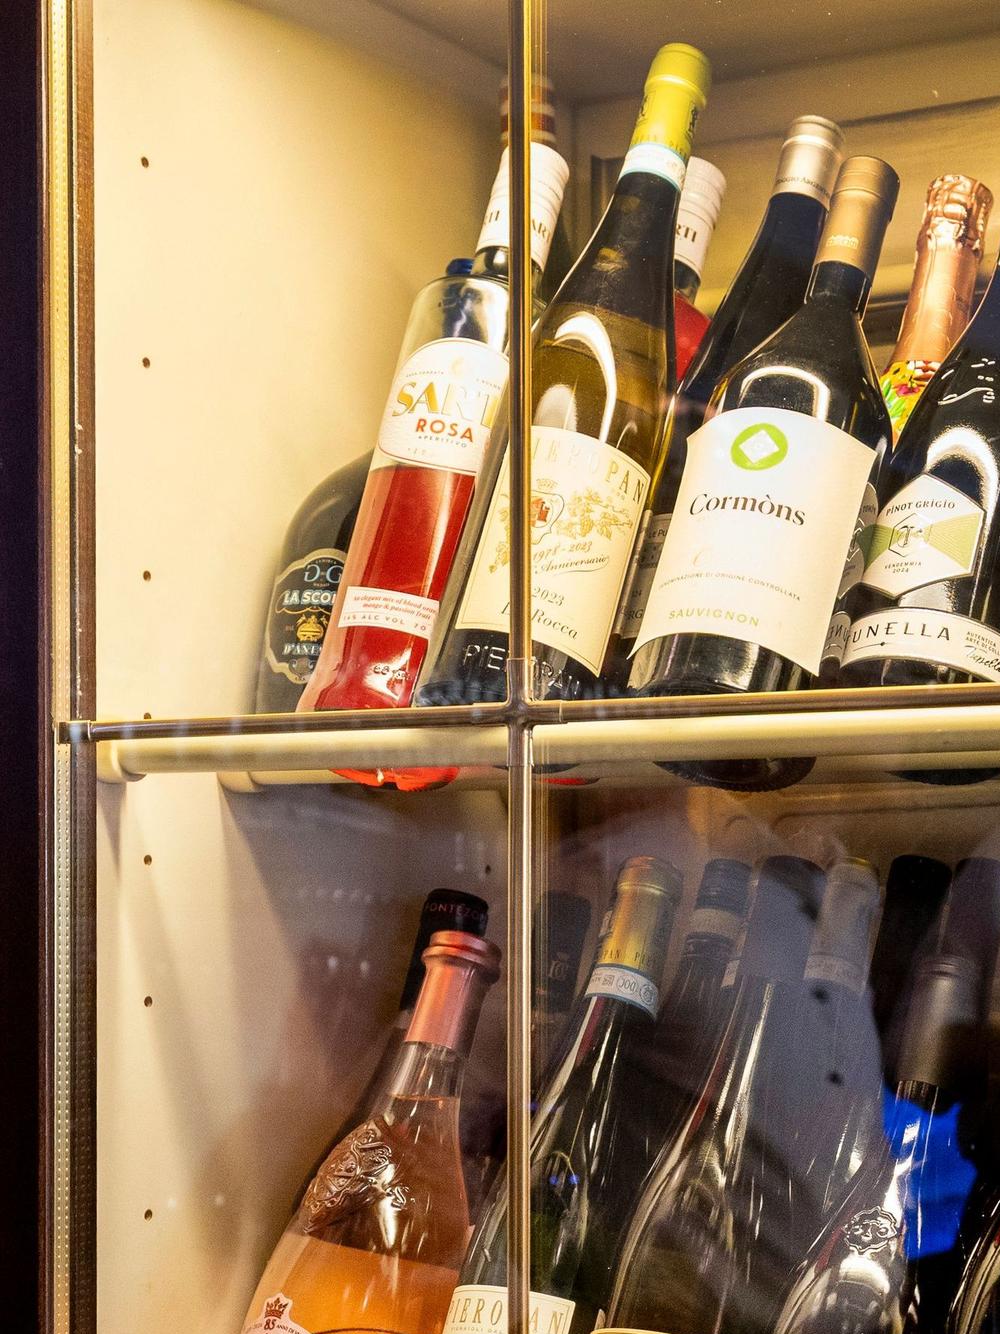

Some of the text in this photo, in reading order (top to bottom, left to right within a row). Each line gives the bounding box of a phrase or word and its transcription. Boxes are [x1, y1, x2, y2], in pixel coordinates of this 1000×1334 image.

[416, 418, 474, 443] ROSA
[689, 494, 807, 527] Cormòns
[532, 587, 565, 607] 2023
[531, 605, 579, 640] Rocca
[667, 607, 760, 627] SAUVIGNON
[264, 1318, 277, 1330] 85
